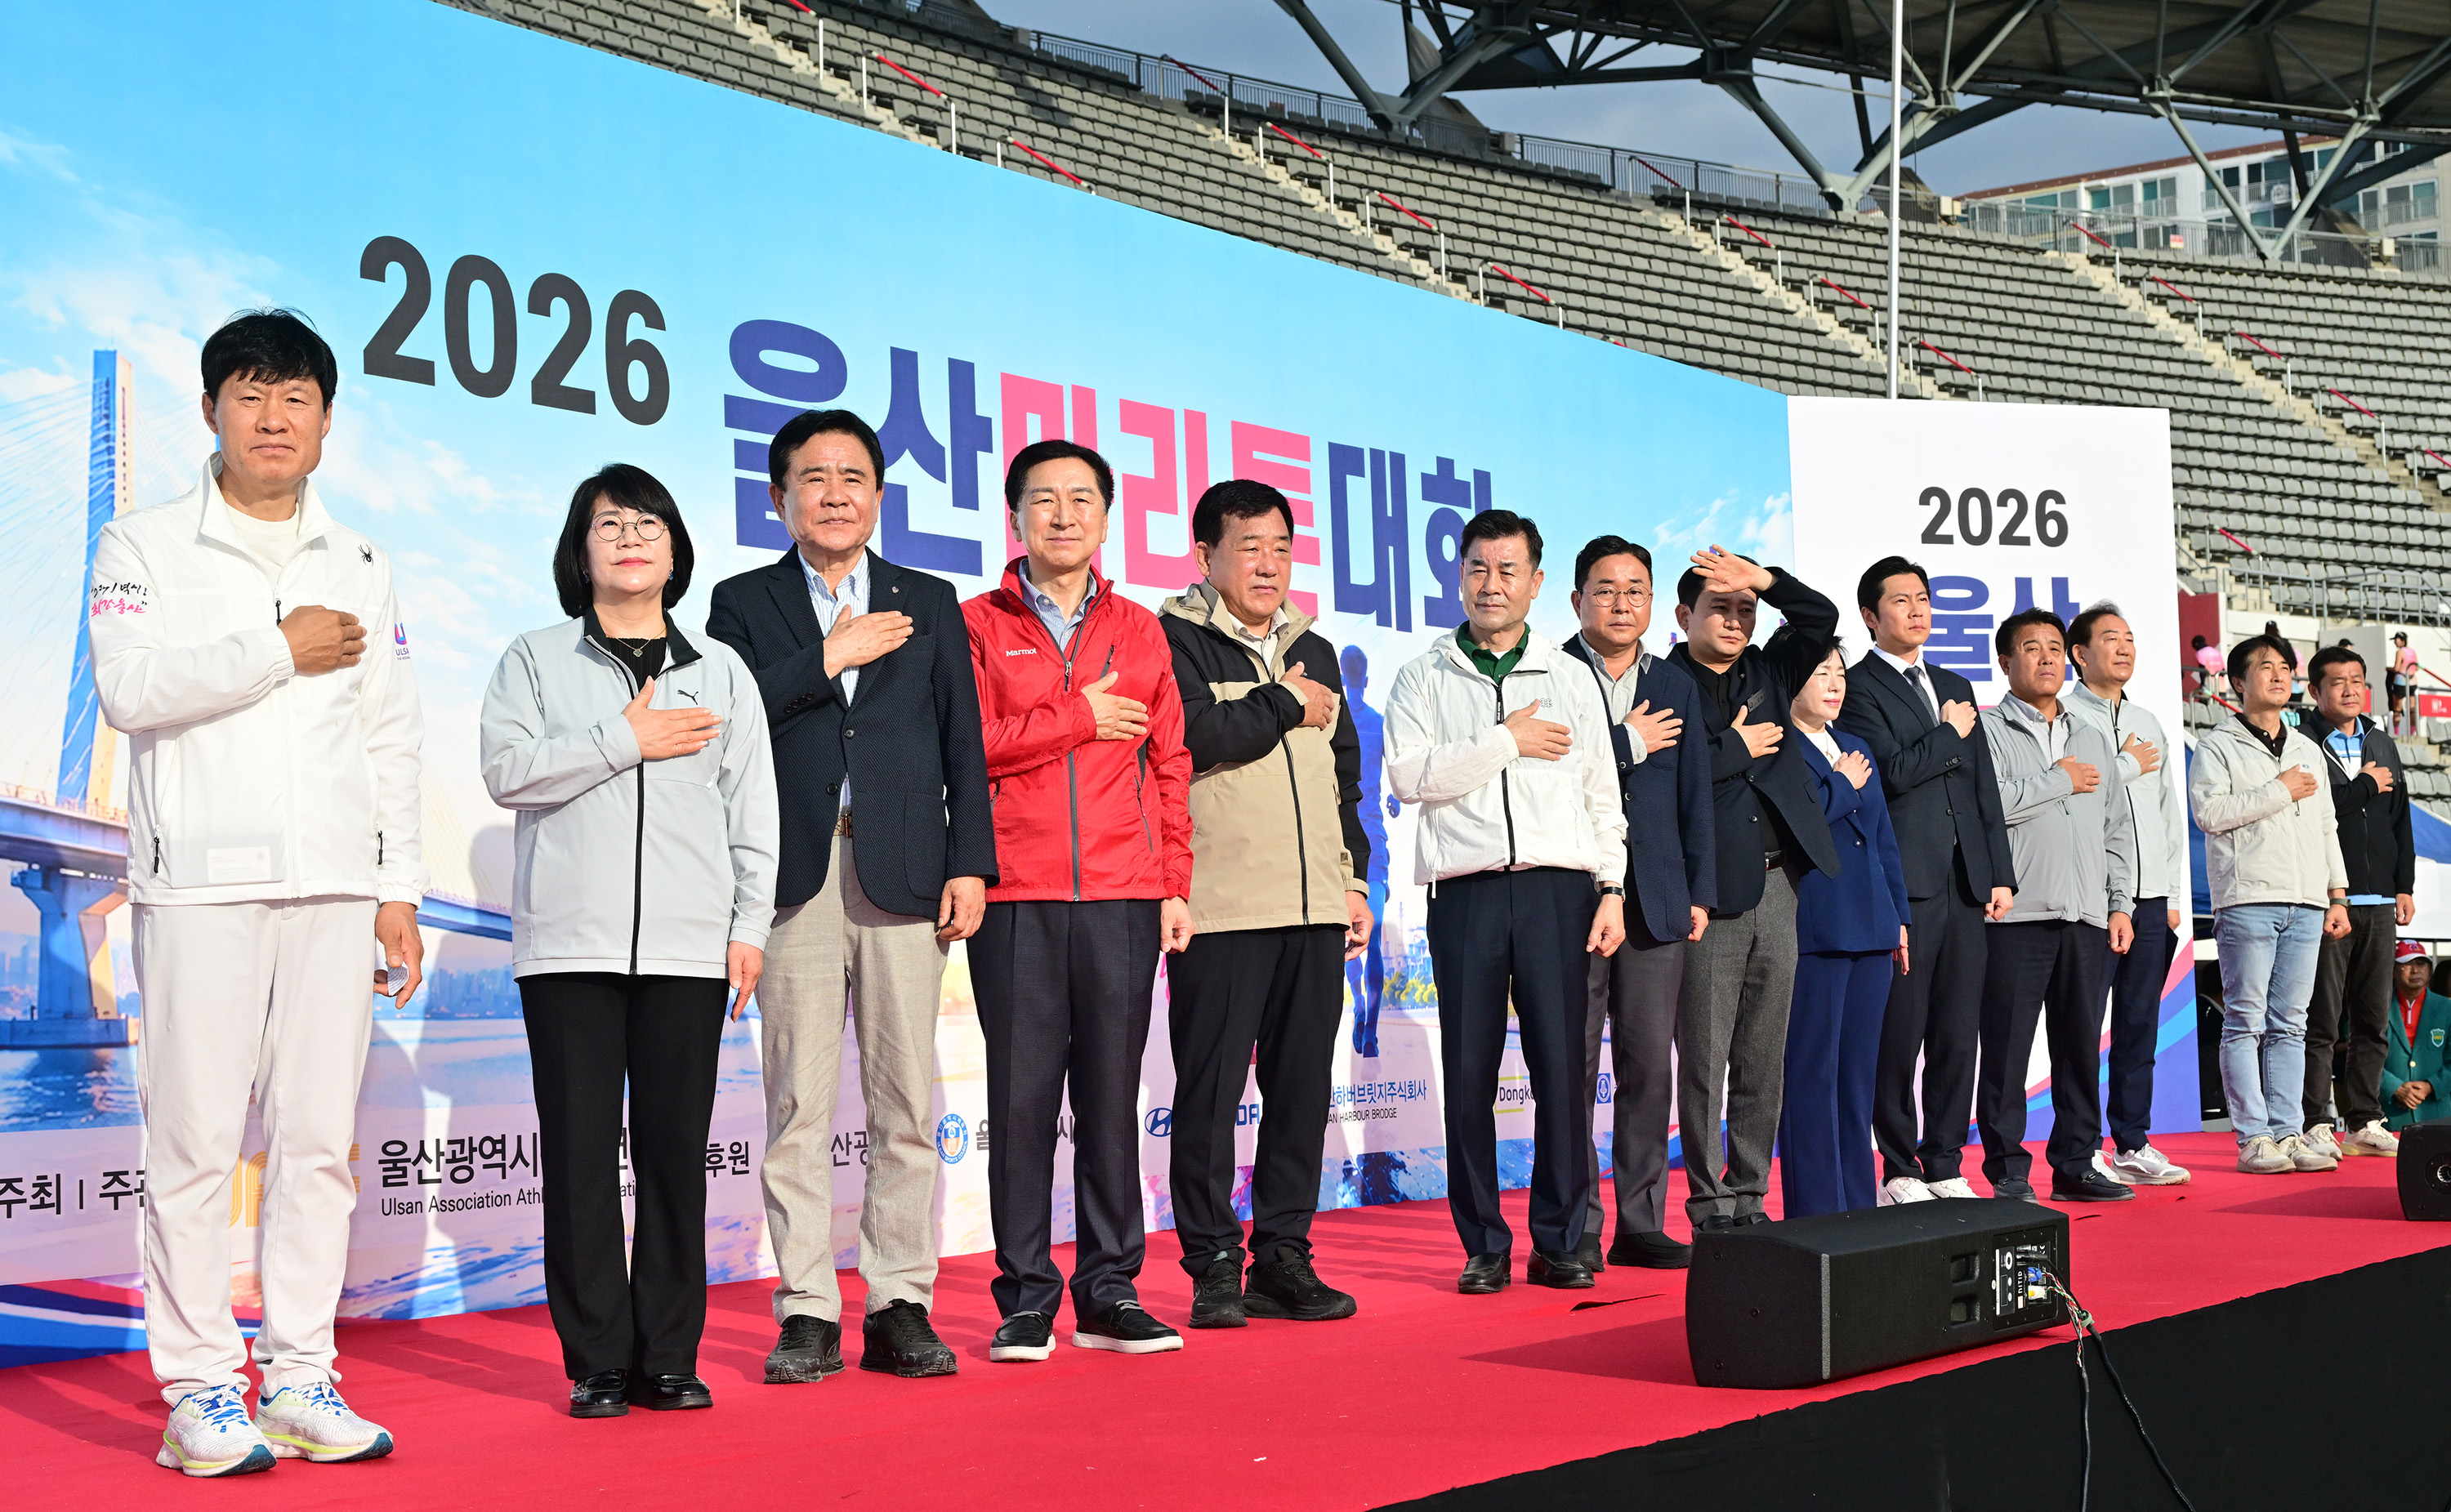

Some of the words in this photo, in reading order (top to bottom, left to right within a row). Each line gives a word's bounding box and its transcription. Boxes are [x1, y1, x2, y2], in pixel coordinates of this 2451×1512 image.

[359, 235, 670, 426] 2026
[1918, 486, 2069, 547] 2026
[395, 647, 409, 656] ULSA
[1006, 647, 1038, 657] Marmot
[1339, 1109, 1370, 1123] HARBOUR
[378, 1132, 538, 1188] 울산광역시
[705, 1141, 750, 1178] 후원
[0, 1173, 61, 1219] 주최
[382, 1197, 423, 1216] Ulsan
[428, 1190, 511, 1213] Association
